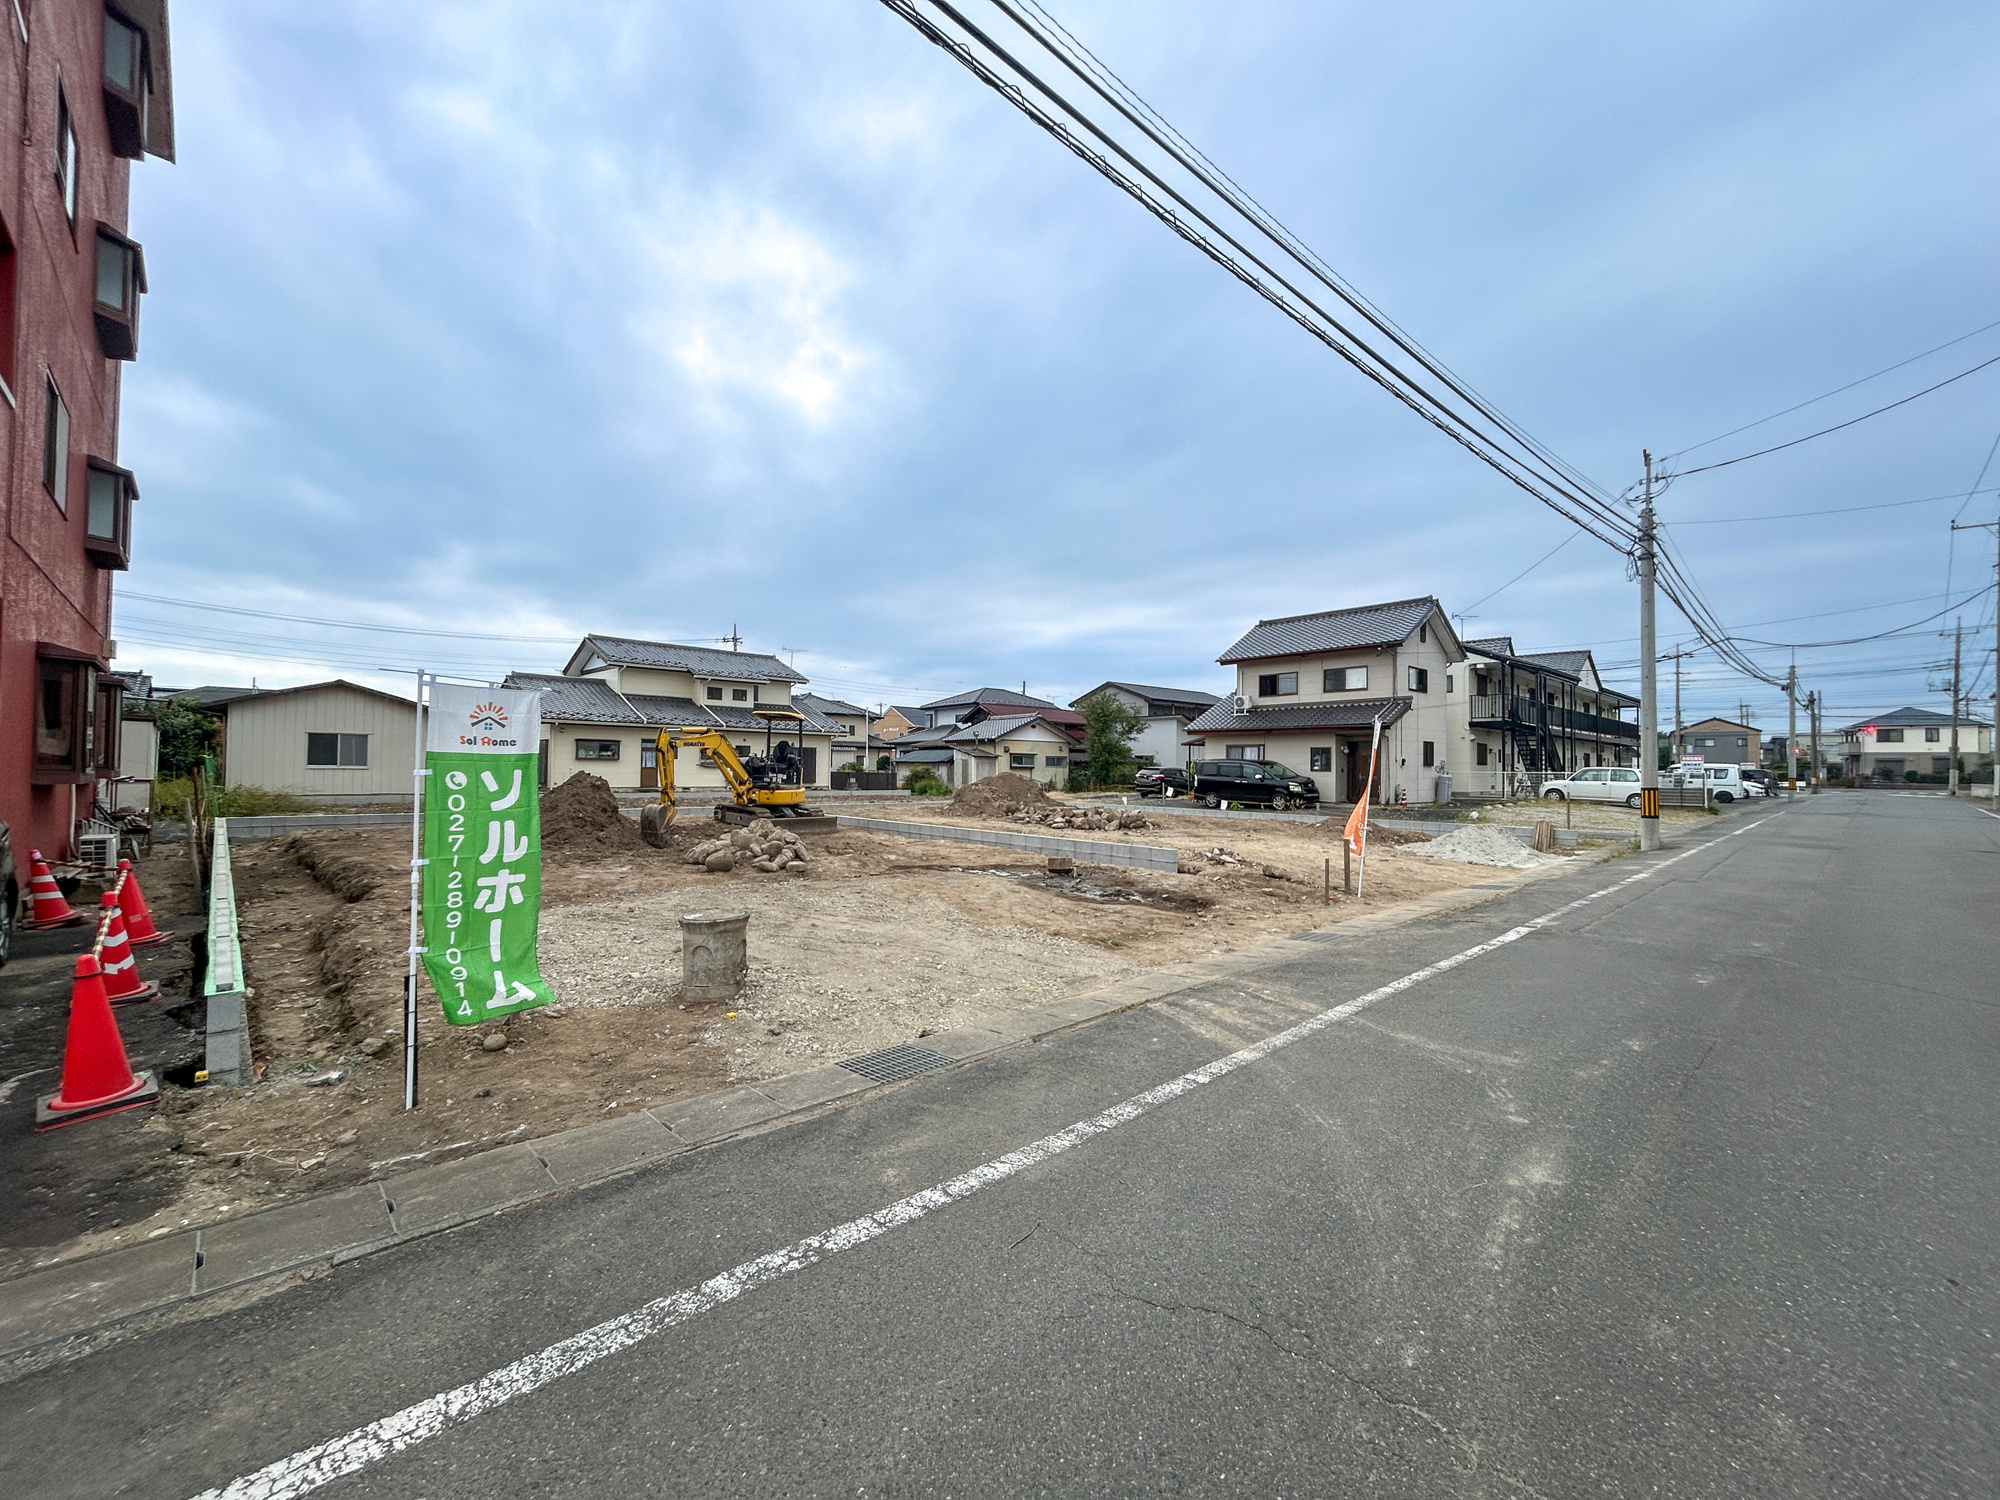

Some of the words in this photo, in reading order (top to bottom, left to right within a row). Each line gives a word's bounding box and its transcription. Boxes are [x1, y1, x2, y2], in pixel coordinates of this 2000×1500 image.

[460, 735, 477, 746] Sol
[481, 736, 517, 747] Home
[474, 769, 536, 1009] ソルホーム
